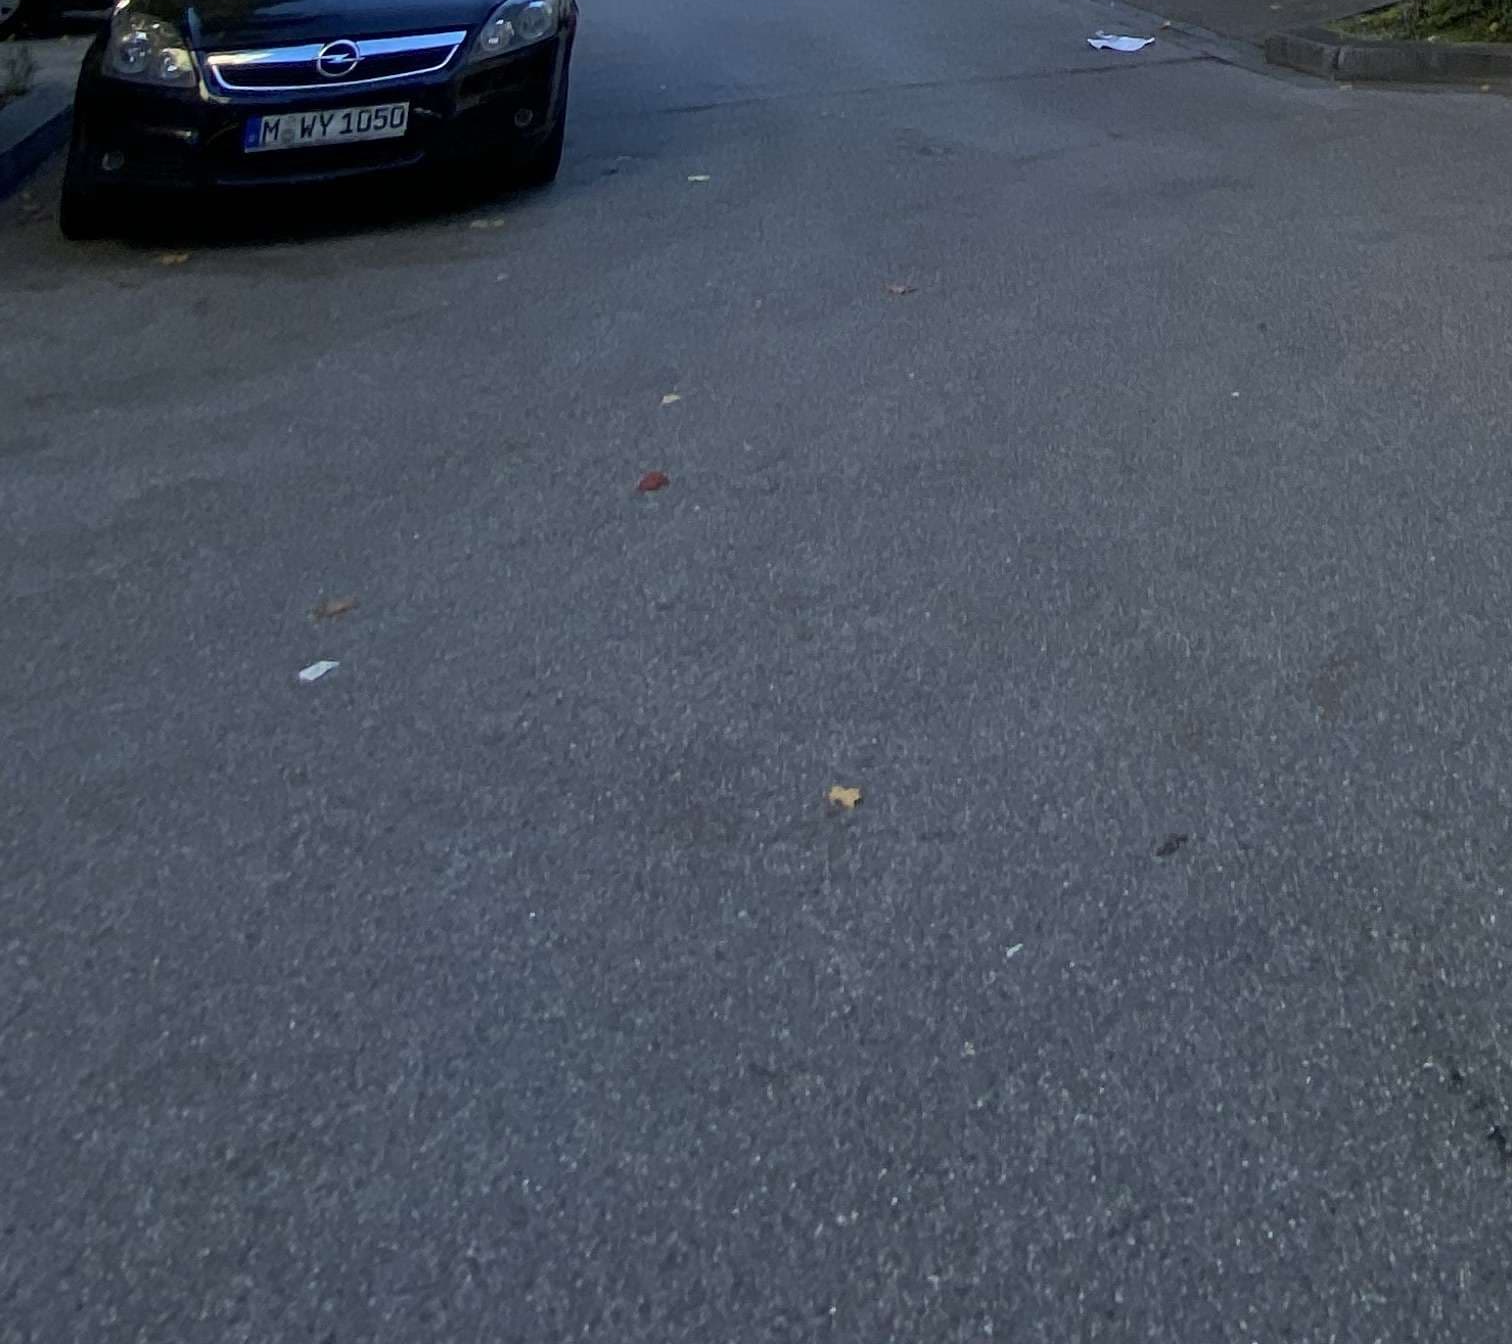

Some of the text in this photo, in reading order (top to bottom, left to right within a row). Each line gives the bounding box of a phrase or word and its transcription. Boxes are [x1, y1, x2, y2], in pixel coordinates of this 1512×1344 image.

[262, 107, 405, 144] M WY 1050
